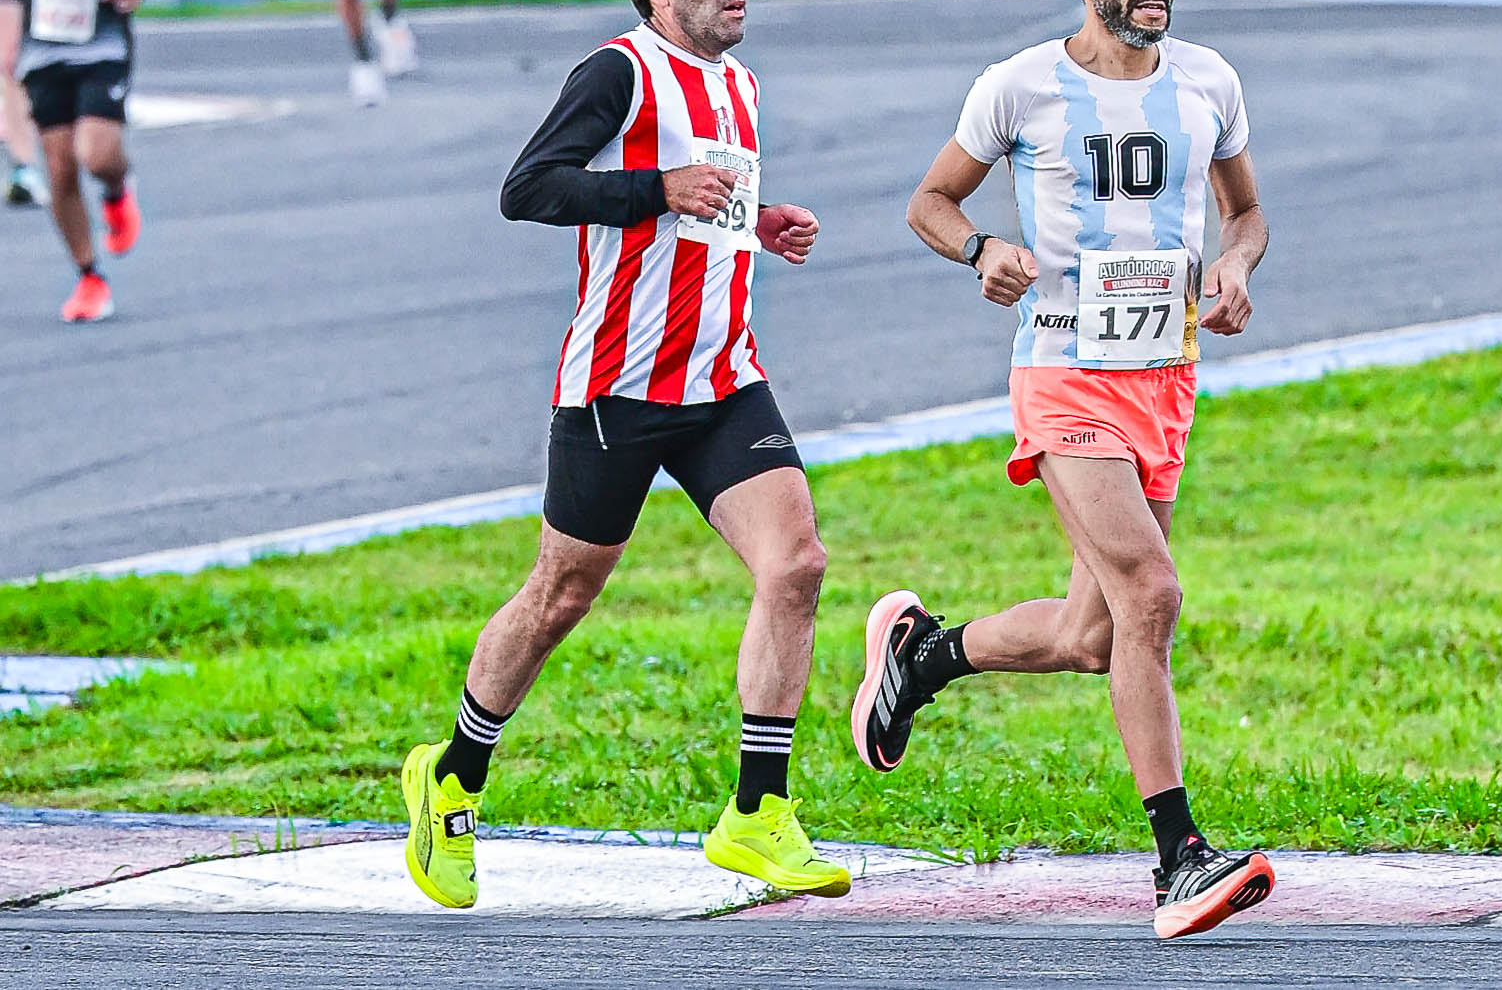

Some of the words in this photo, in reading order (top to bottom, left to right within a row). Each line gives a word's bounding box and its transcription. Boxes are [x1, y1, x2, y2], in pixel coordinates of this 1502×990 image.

[1084, 132, 1167, 201] 10
[1098, 256, 1176, 280] AUTÓDROMO
[1099, 304, 1171, 341] 177
